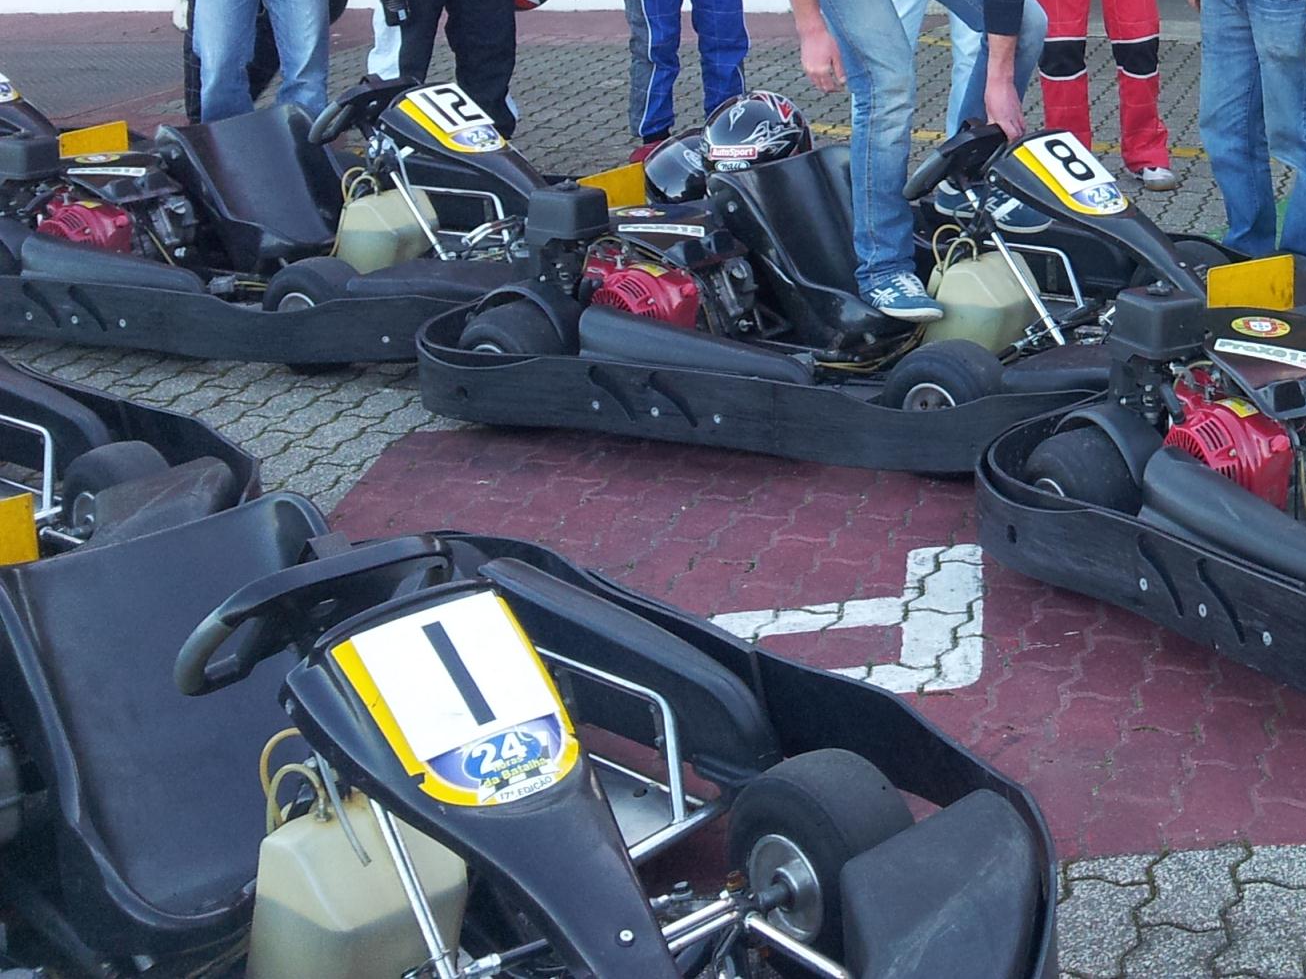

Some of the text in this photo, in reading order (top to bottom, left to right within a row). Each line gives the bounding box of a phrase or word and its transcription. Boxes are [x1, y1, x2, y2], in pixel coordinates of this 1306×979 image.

[418, 87, 486, 126] 12
[711, 147, 753, 157] AutoSport
[1044, 139, 1096, 181] 8
[421, 621, 497, 726] 1
[471, 732, 528, 775] 24
